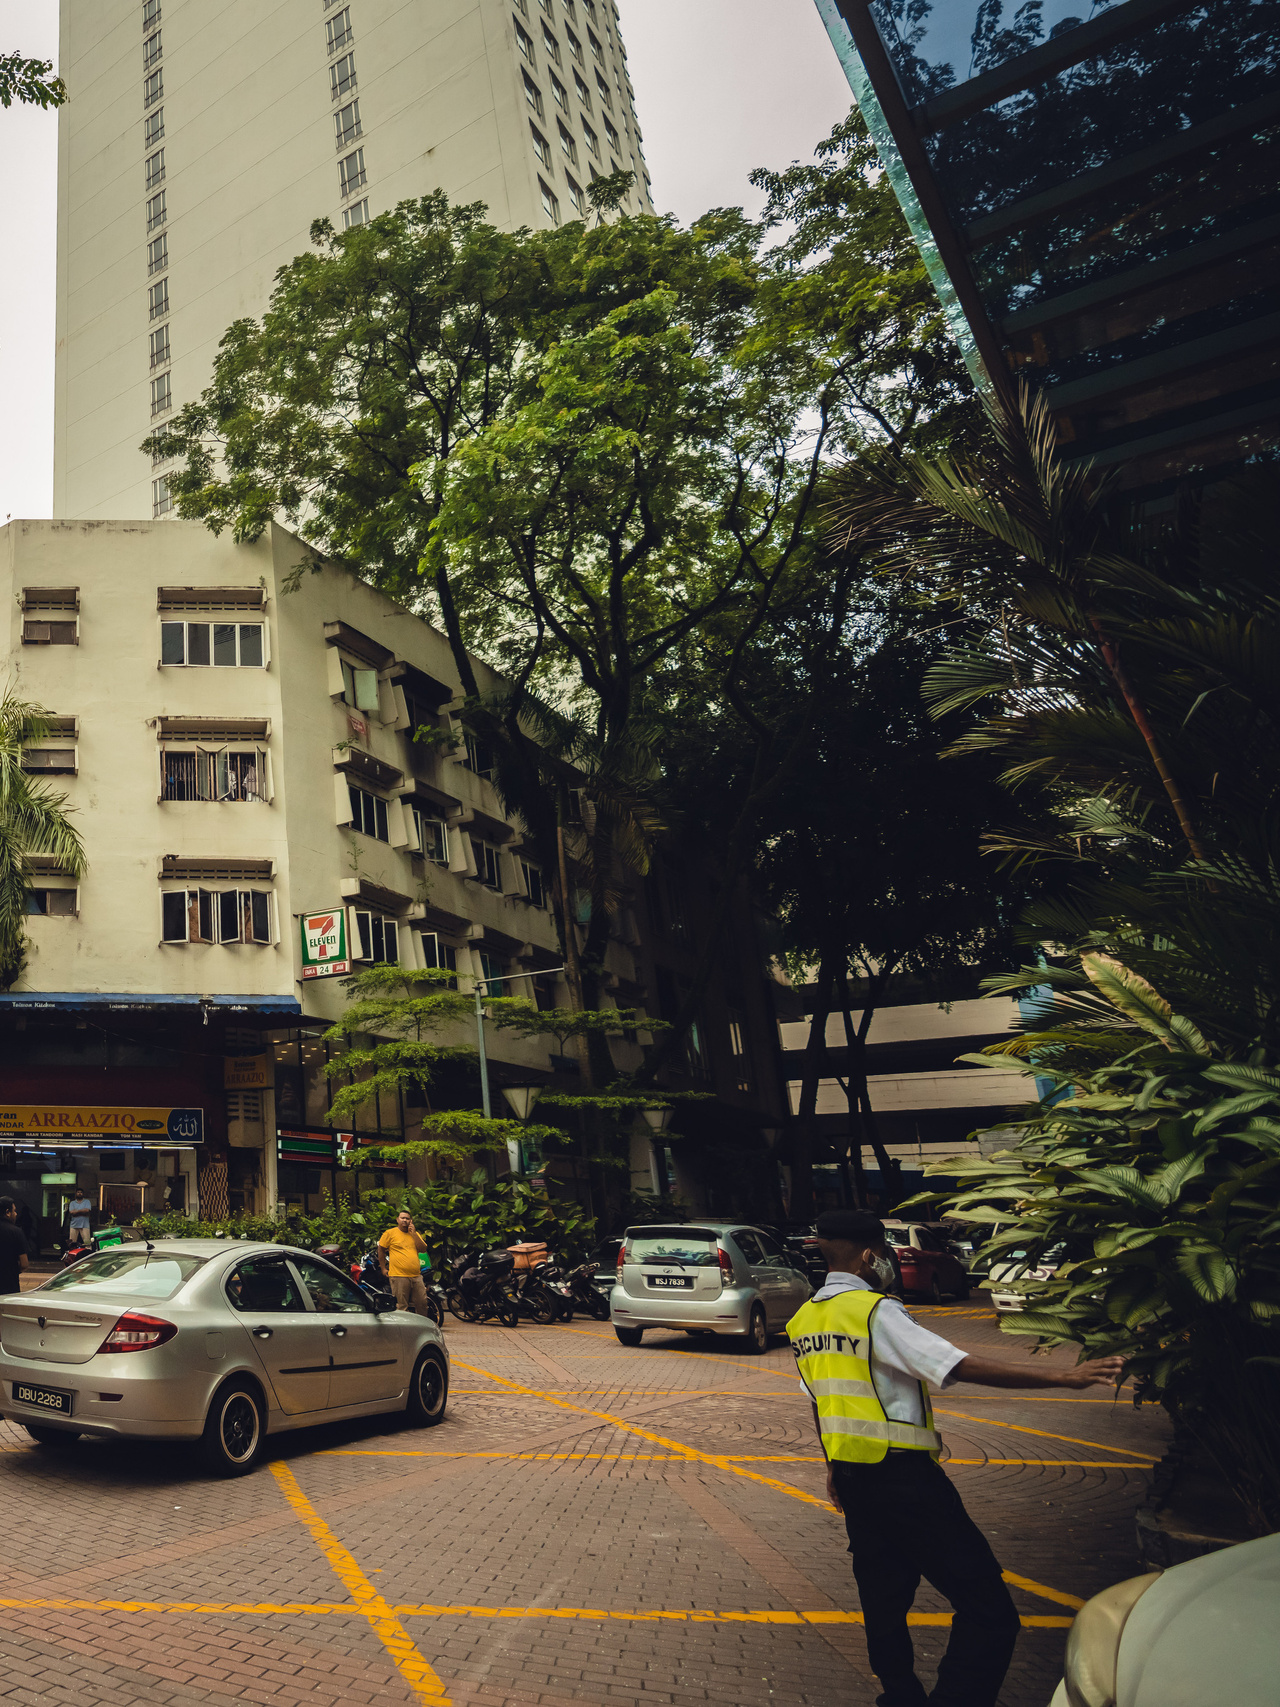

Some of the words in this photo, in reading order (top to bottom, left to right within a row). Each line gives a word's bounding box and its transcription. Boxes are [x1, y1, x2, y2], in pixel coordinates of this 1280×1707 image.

[320, 966, 329, 974] 24
[28, 1112, 136, 1132] ARRAAZIQ
[18, 1386, 37, 1402] DBU
